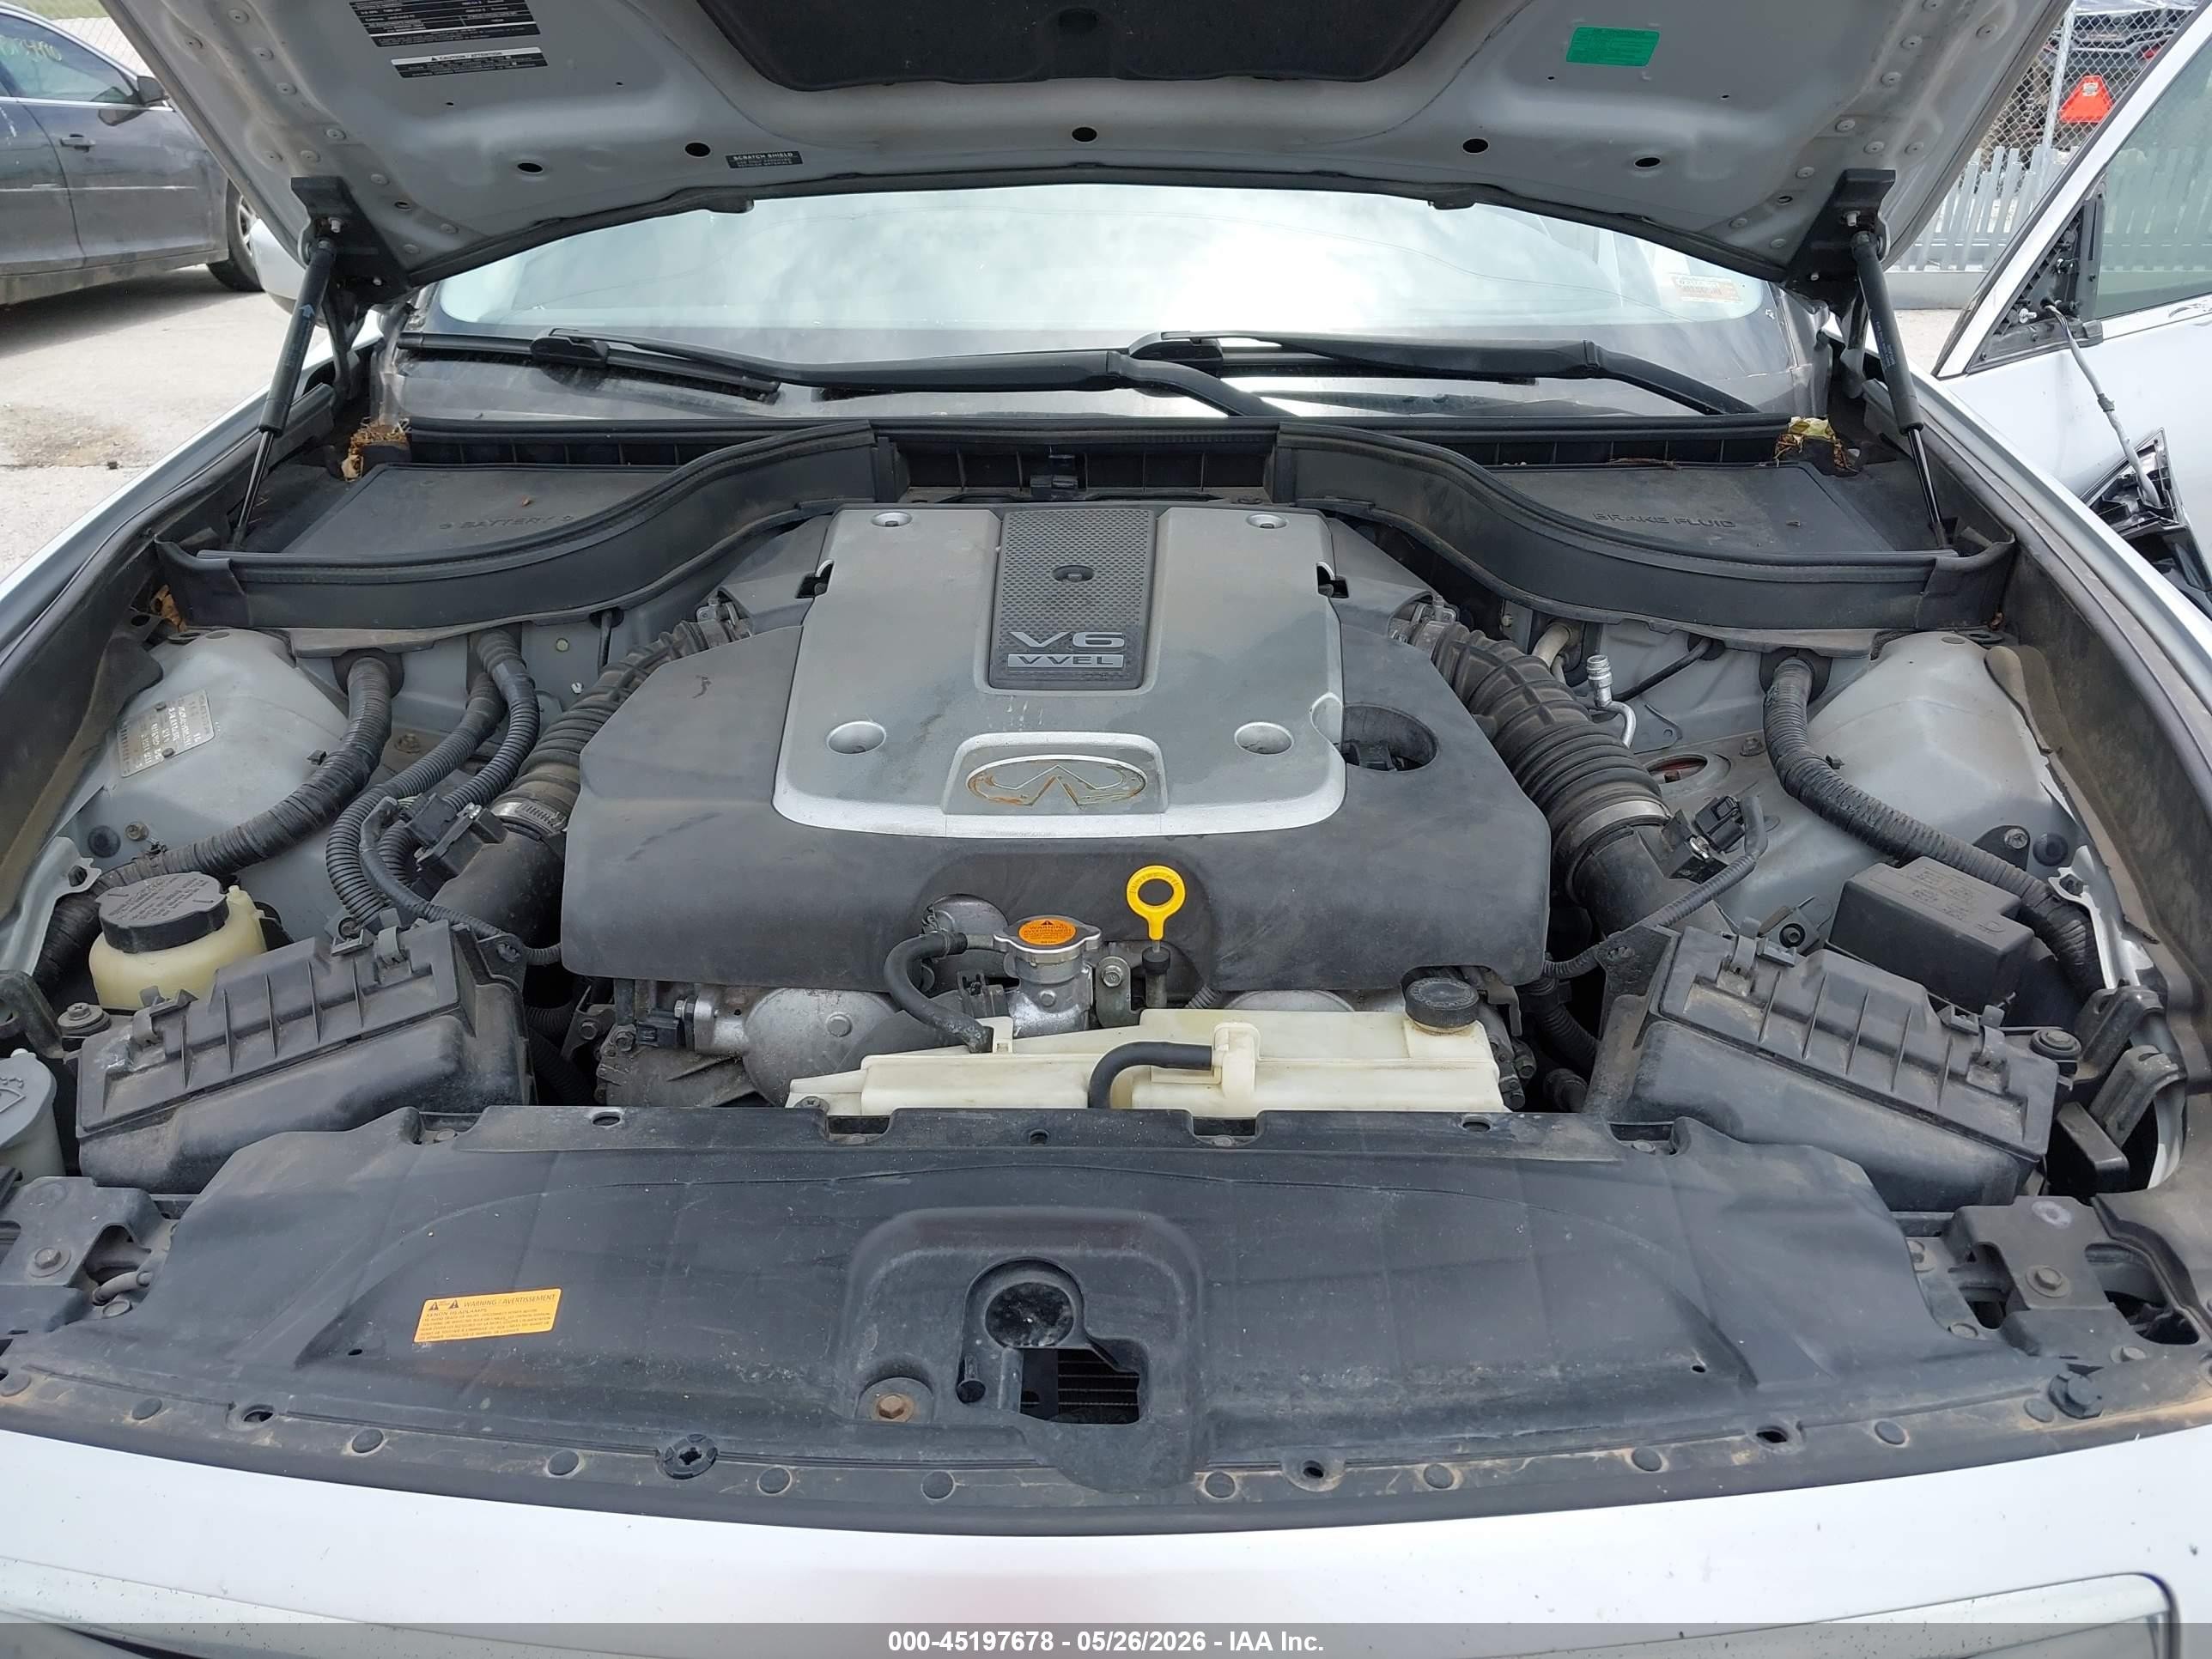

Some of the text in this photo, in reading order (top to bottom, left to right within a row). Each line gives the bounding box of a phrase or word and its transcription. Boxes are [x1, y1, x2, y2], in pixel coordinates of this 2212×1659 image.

[460, 515, 554, 529] BATTERY
[1592, 514, 1736, 528] BRAKE FLUID
[1008, 631, 1125, 648] V6
[1018, 655, 1114, 665] VVEL
[502, 1294, 556, 1305] AVERTISSEMENT
